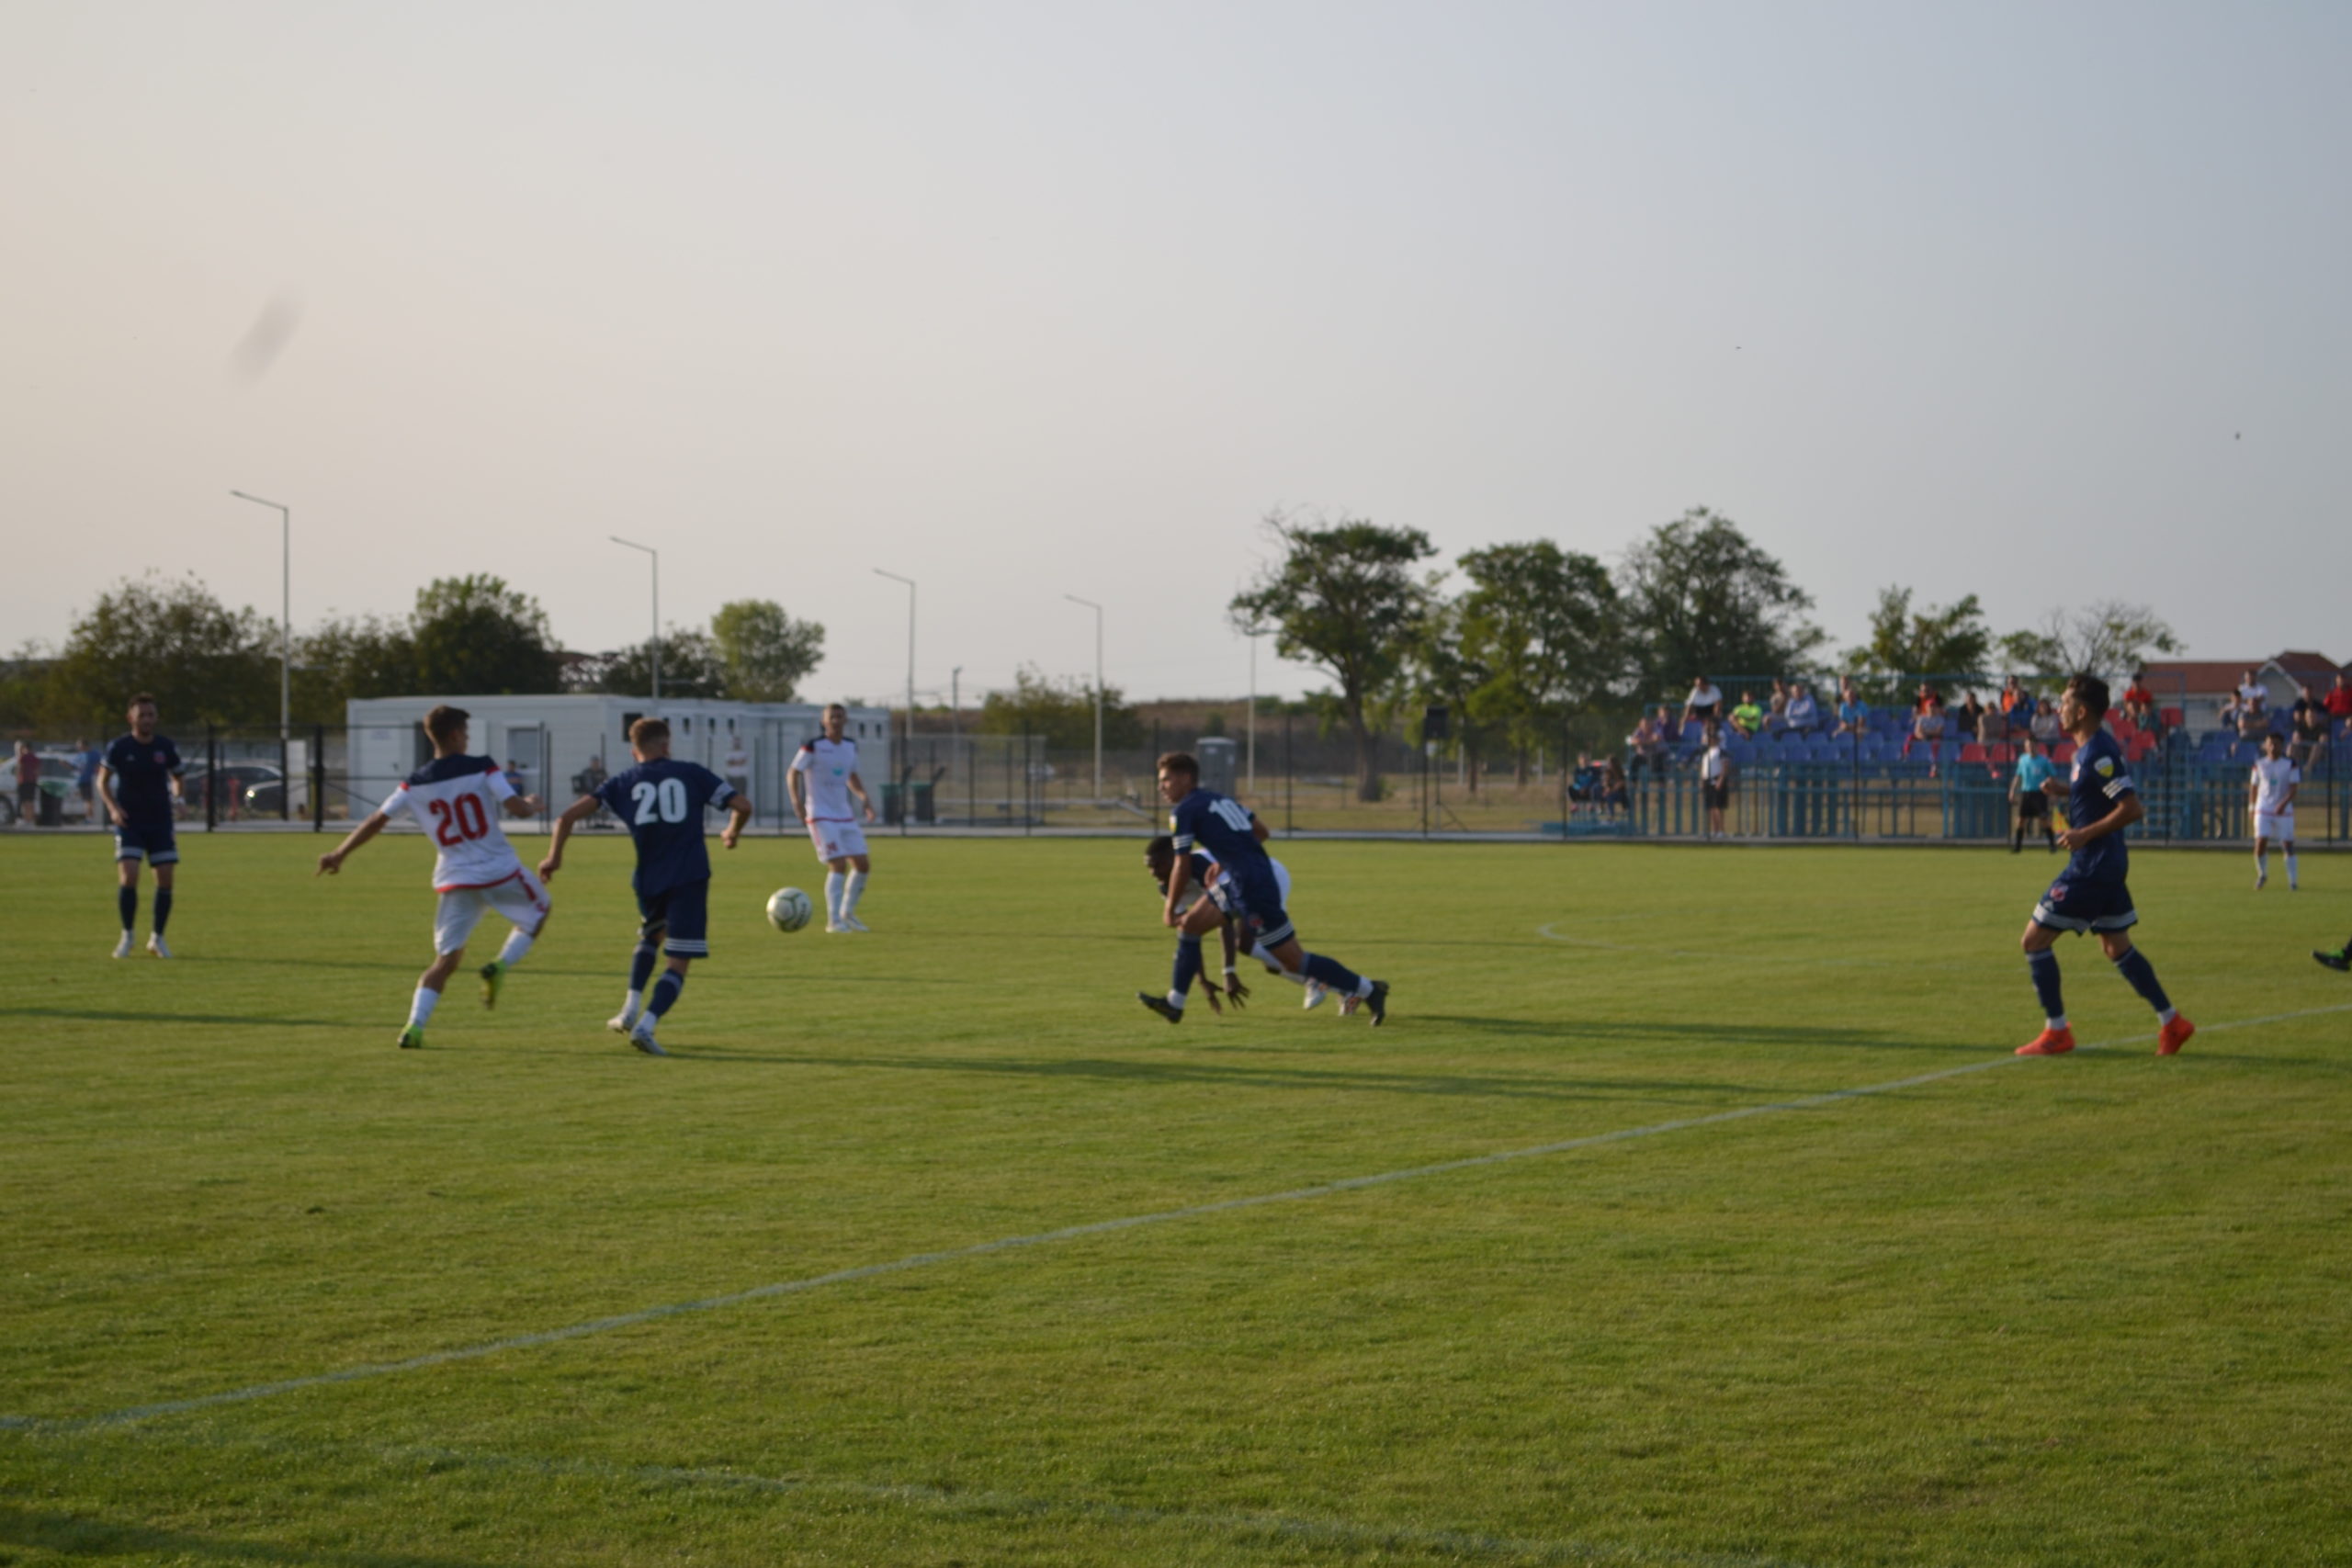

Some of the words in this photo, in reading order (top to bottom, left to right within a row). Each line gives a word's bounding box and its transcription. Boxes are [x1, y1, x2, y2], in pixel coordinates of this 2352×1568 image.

[429, 792, 489, 847] 20
[631, 777, 687, 826] 20
[1208, 798, 1252, 831] 10
